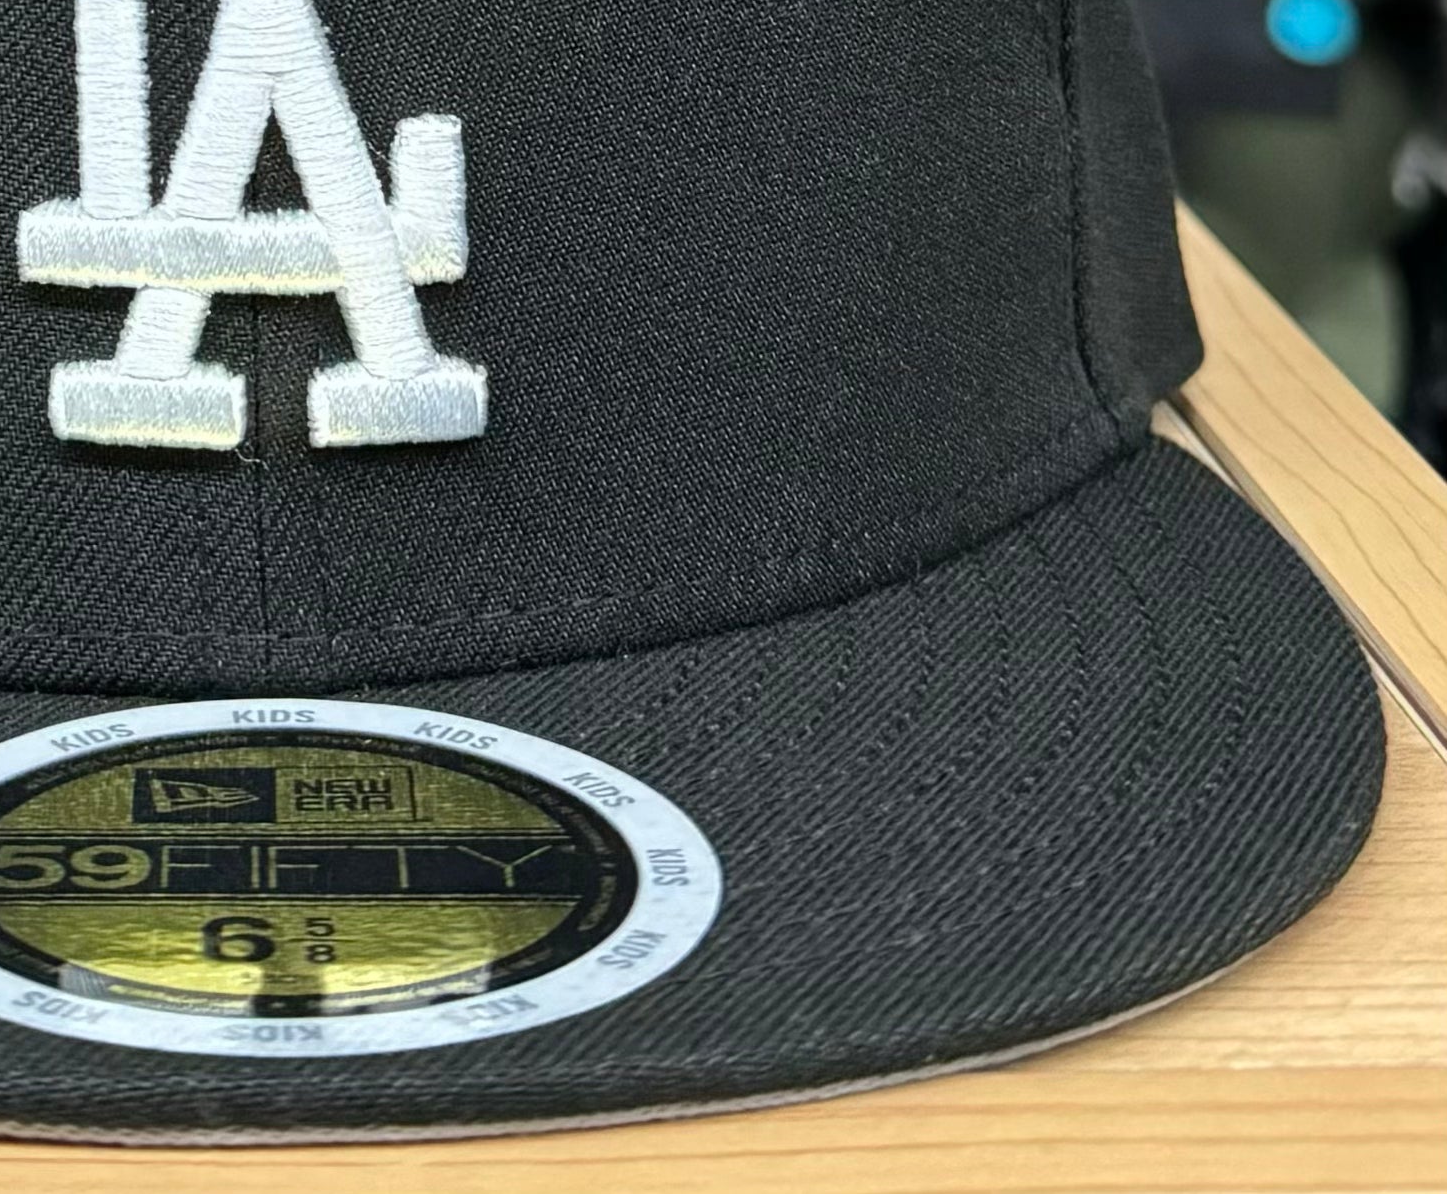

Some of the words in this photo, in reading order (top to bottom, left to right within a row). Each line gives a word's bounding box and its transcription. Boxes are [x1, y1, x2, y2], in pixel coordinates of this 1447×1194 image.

[232, 709, 316, 725] KIDS
[51, 722, 136, 753] KIDS
[413, 720, 498, 751] KIDS
[294, 778, 392, 794] NEW
[562, 771, 636, 810] KIDS
[294, 795, 394, 812] ERA
[646, 848, 690, 886] KIDS
[201, 916, 276, 963] 6
[597, 929, 668, 969] KIDS
[12, 990, 109, 1025] KIDS
[221, 1024, 323, 1043] KIDS
